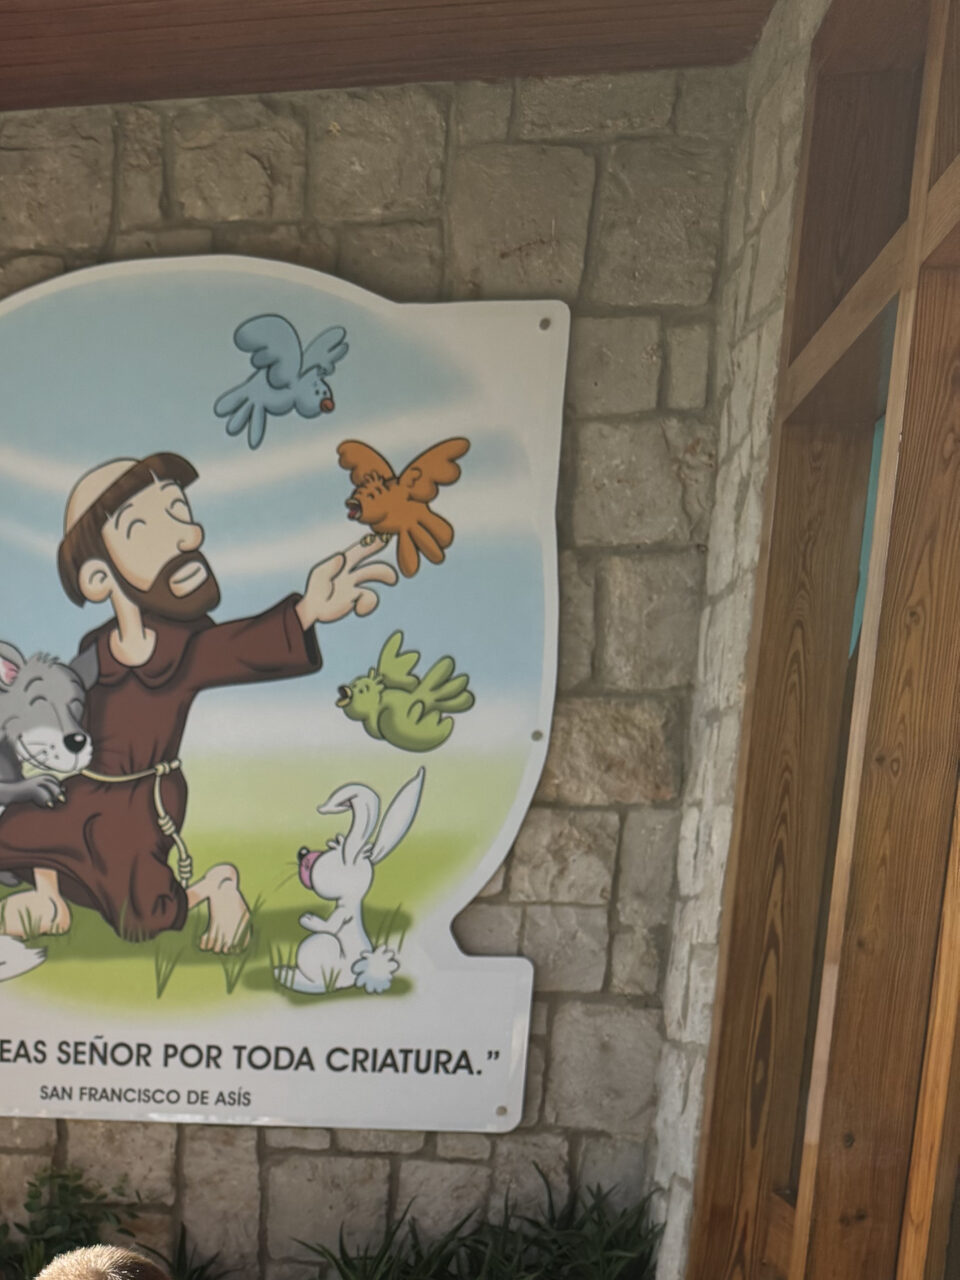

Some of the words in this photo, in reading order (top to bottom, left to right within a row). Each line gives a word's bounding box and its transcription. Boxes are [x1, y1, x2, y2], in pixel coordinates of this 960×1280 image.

[56, 1034, 153, 1068] SEÑOR
[162, 1042, 223, 1070] POR
[231, 1044, 316, 1073] TODA
[325, 1046, 501, 1077] CRIATURA.”
[39, 1084, 74, 1101] SAN
[78, 1085, 182, 1105] FRANCISCO
[186, 1089, 210, 1106] DE
[213, 1086, 252, 1108] ASÍS
